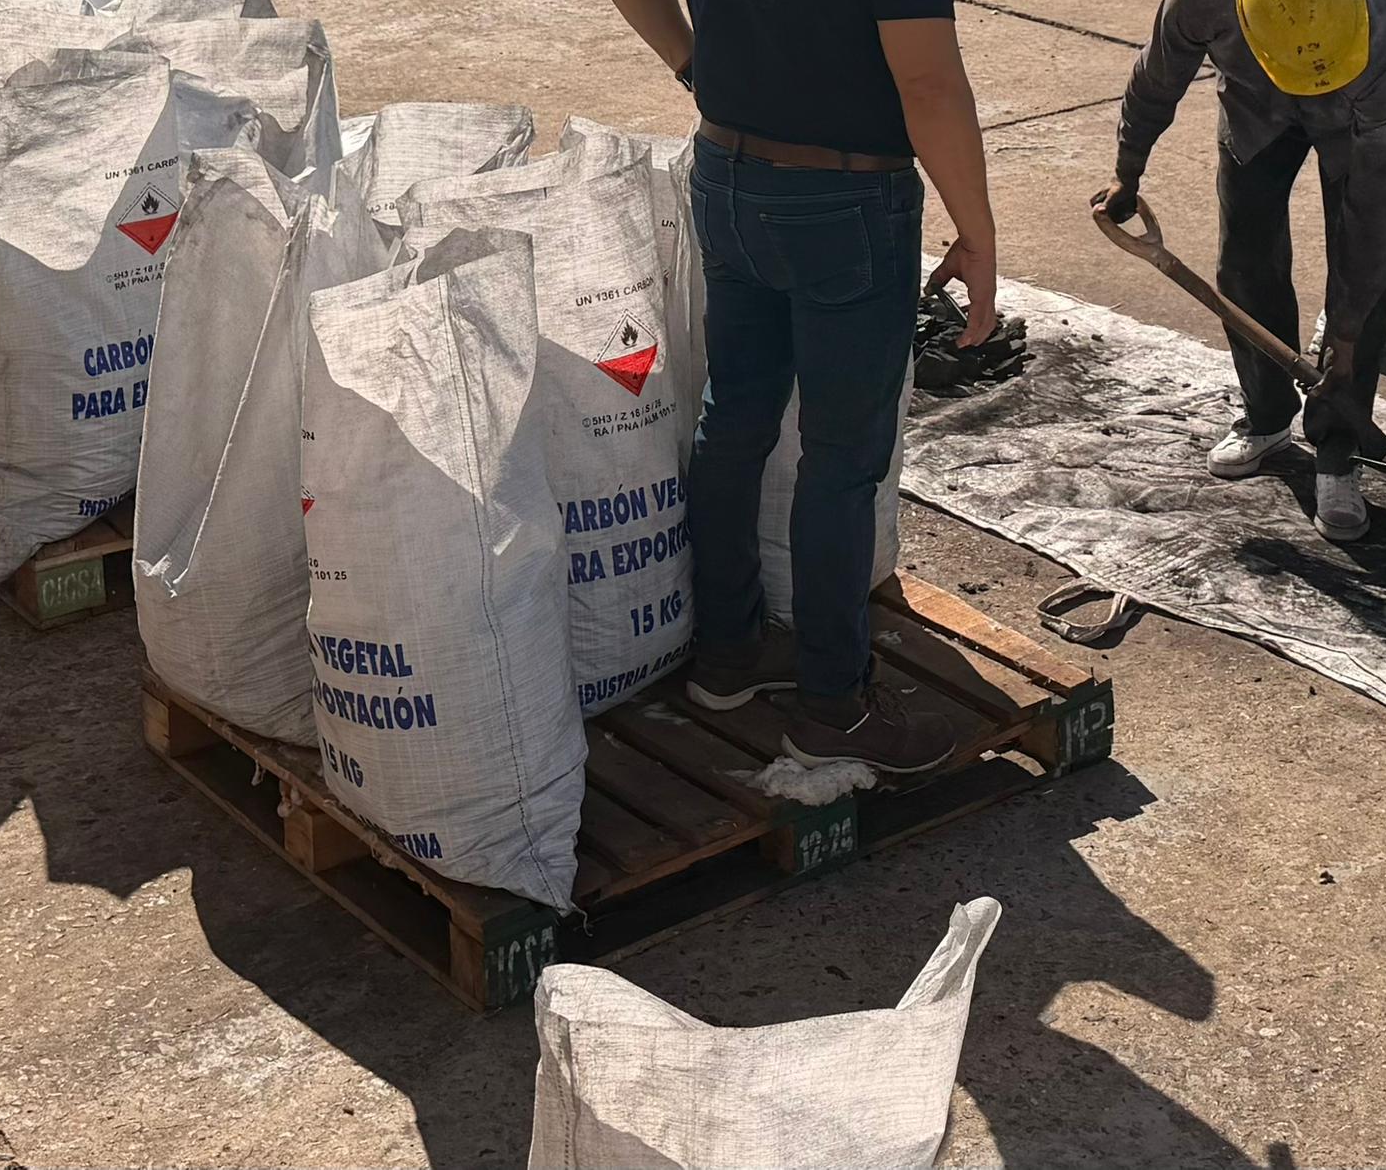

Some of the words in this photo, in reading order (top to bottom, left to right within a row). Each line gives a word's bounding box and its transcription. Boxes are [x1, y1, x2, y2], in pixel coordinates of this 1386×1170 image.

[104, 170, 120, 180] UN
[122, 165, 145, 177] 1361
[576, 295, 593, 307] UN
[596, 288, 620, 302] 1361
[72, 387, 127, 420] PARA
[592, 413, 613, 426] 5H3
[593, 426, 610, 438] RA
[616, 421, 639, 434] PNA
[557, 484, 648, 534] ARBÓN
[315, 571, 331, 581] 101
[334, 570, 348, 581] 25
[630, 604, 654, 637] 15
[660, 589, 682, 627] KG
[318, 634, 413, 677] VEGETAL
[322, 736, 339, 774] 15
[339, 751, 364, 788] KG
